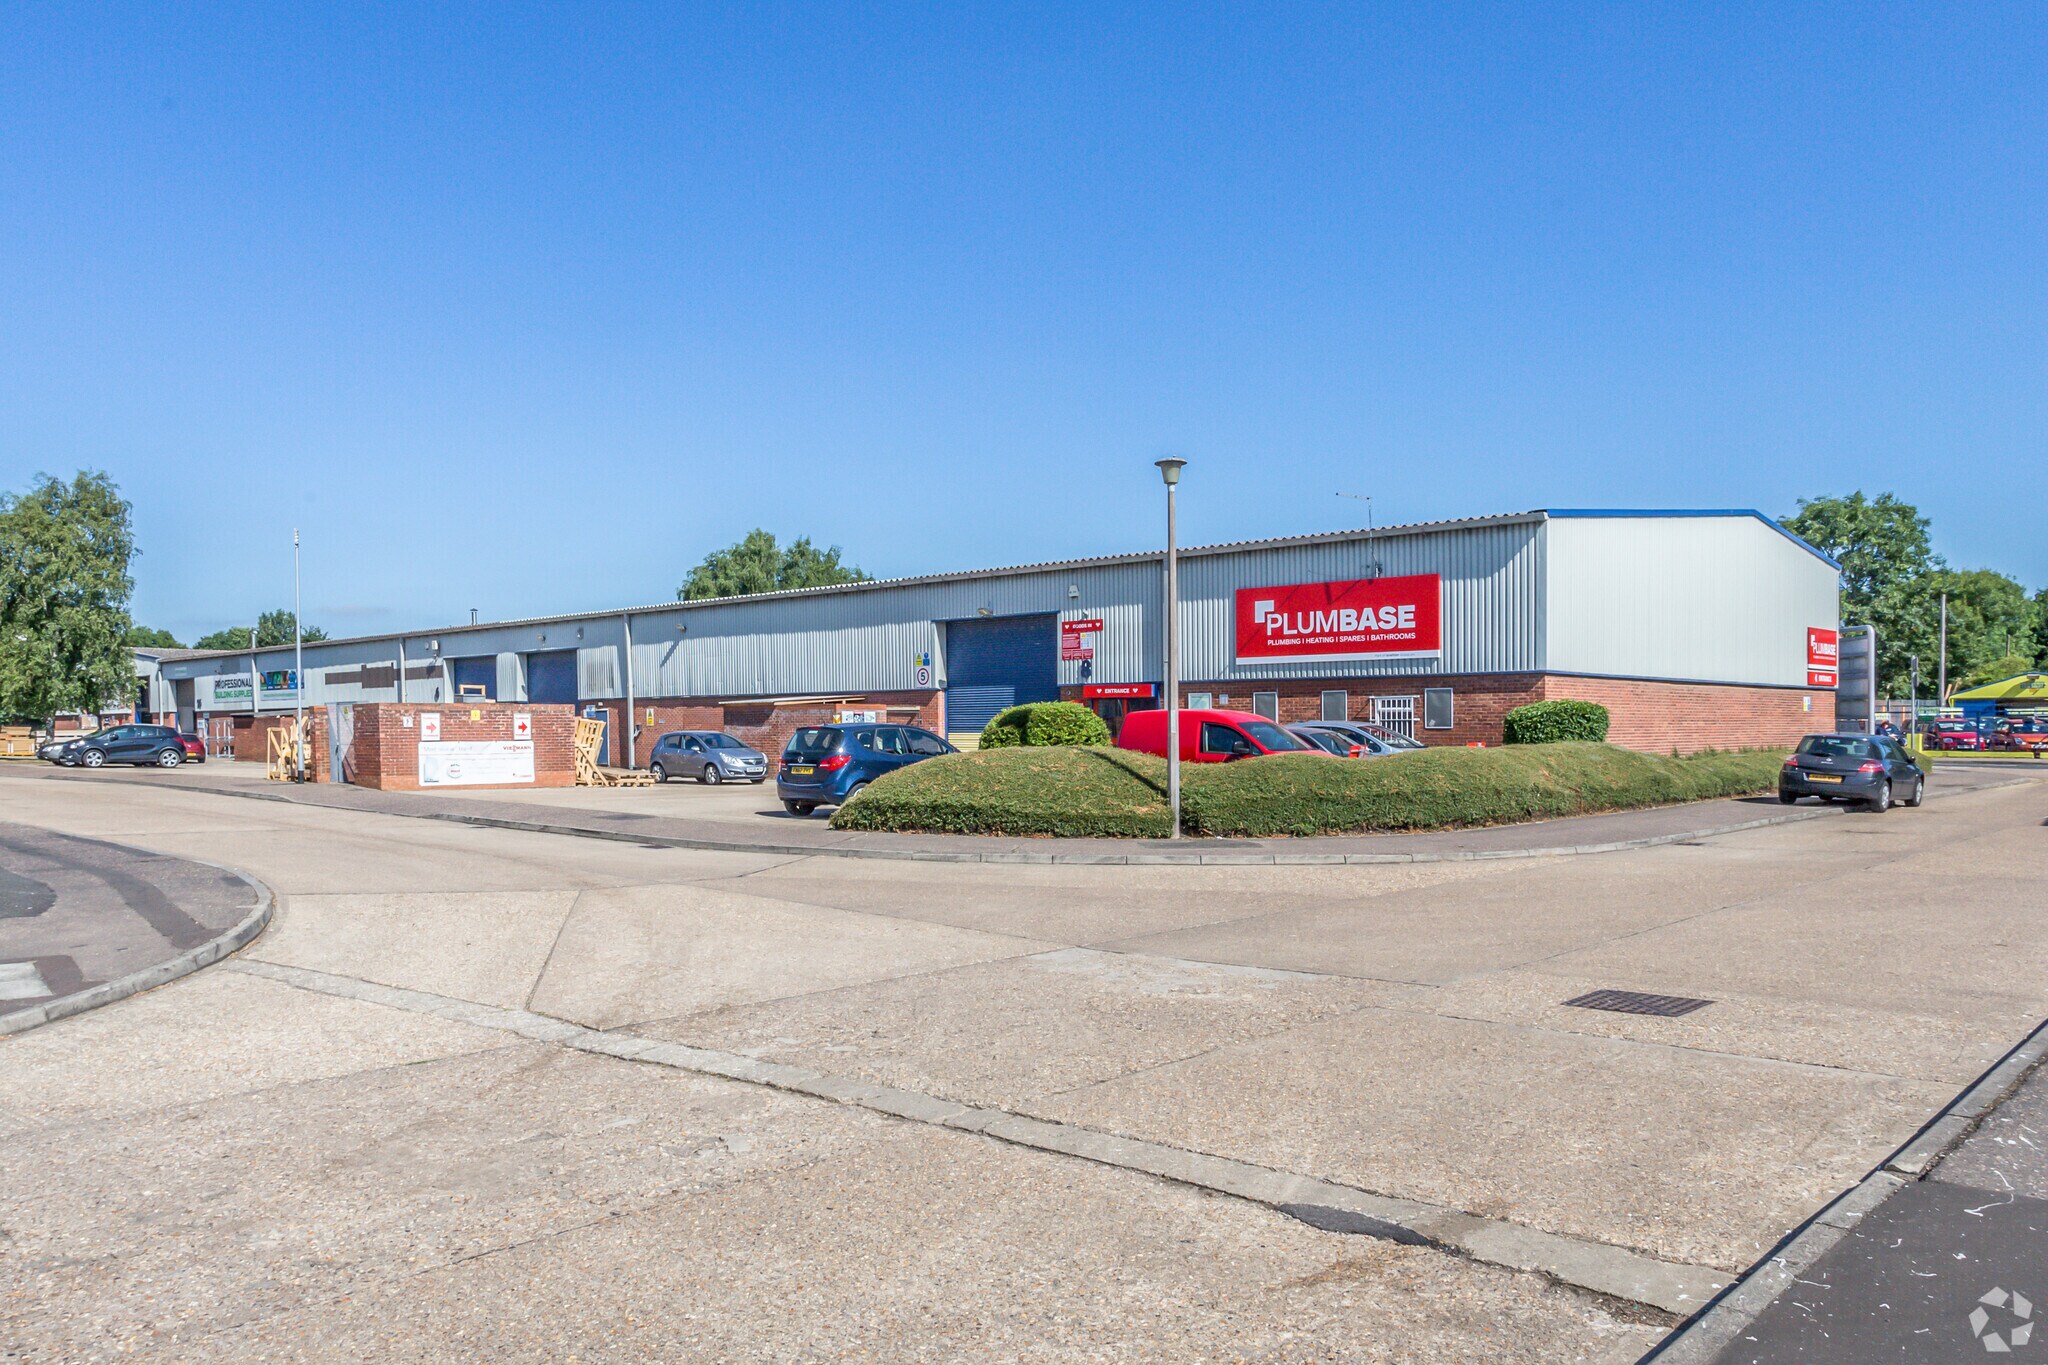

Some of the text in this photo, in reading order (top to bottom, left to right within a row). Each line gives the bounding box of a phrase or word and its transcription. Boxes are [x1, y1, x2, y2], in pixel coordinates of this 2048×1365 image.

[1267, 604, 1416, 636] PLUMBASE
[1267, 638, 1301, 646] PLUMBING
[1306, 636, 1335, 644] HEATING
[1339, 635, 1365, 643] SPARES
[1371, 632, 1416, 641] BATHROOMS
[1813, 642, 1836, 655] PLUMBASE
[920, 671, 926, 682] 5
[214, 678, 252, 689] PROFESSIONAL
[215, 690, 233, 699] BUILDING
